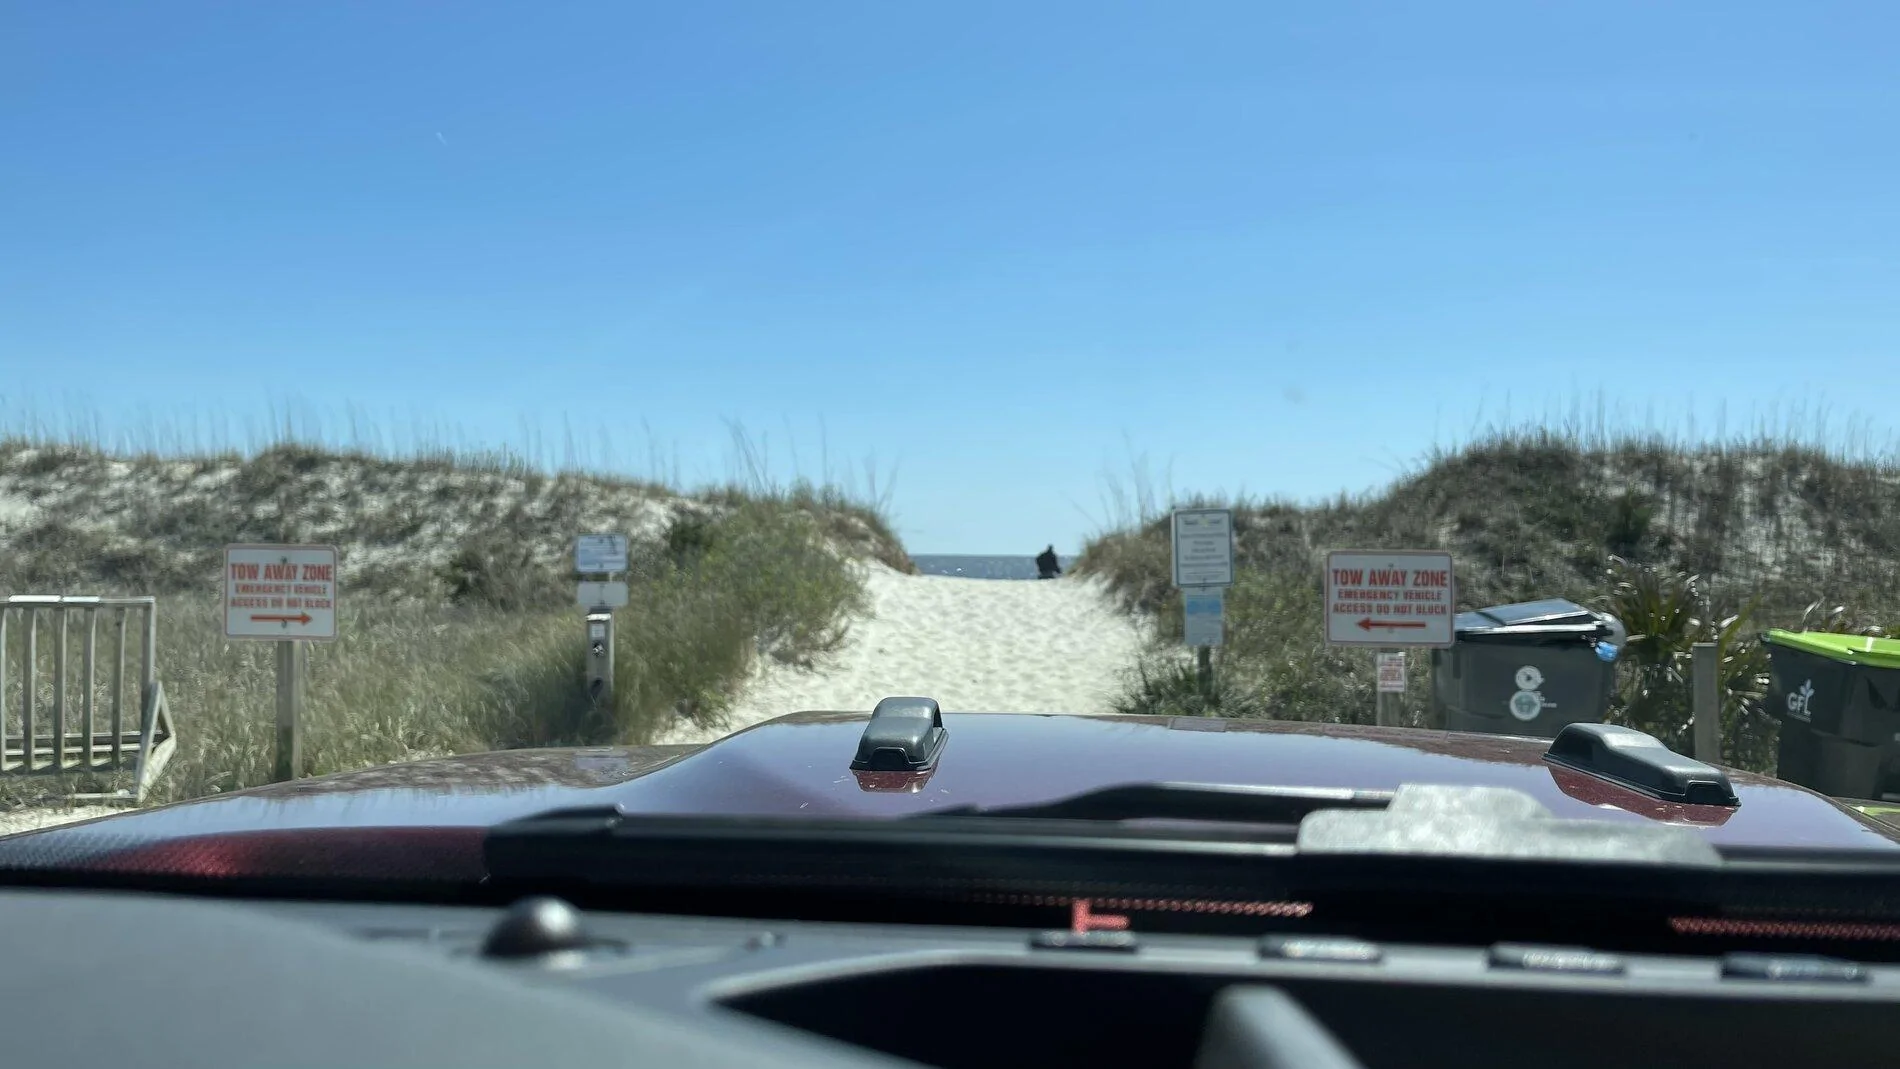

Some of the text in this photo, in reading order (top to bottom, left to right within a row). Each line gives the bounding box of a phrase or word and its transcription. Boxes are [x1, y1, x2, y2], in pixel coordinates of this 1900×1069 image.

[230, 563, 333, 581] TOW AWAY ZONE
[1332, 568, 1448, 587] TOW AWAY ZONE
[1338, 588, 1443, 601] EMERGENCY VEHICLE
[1332, 603, 1448, 615] ACCESS DO NOT BLOCK
[1787, 688, 1813, 715] GFL
